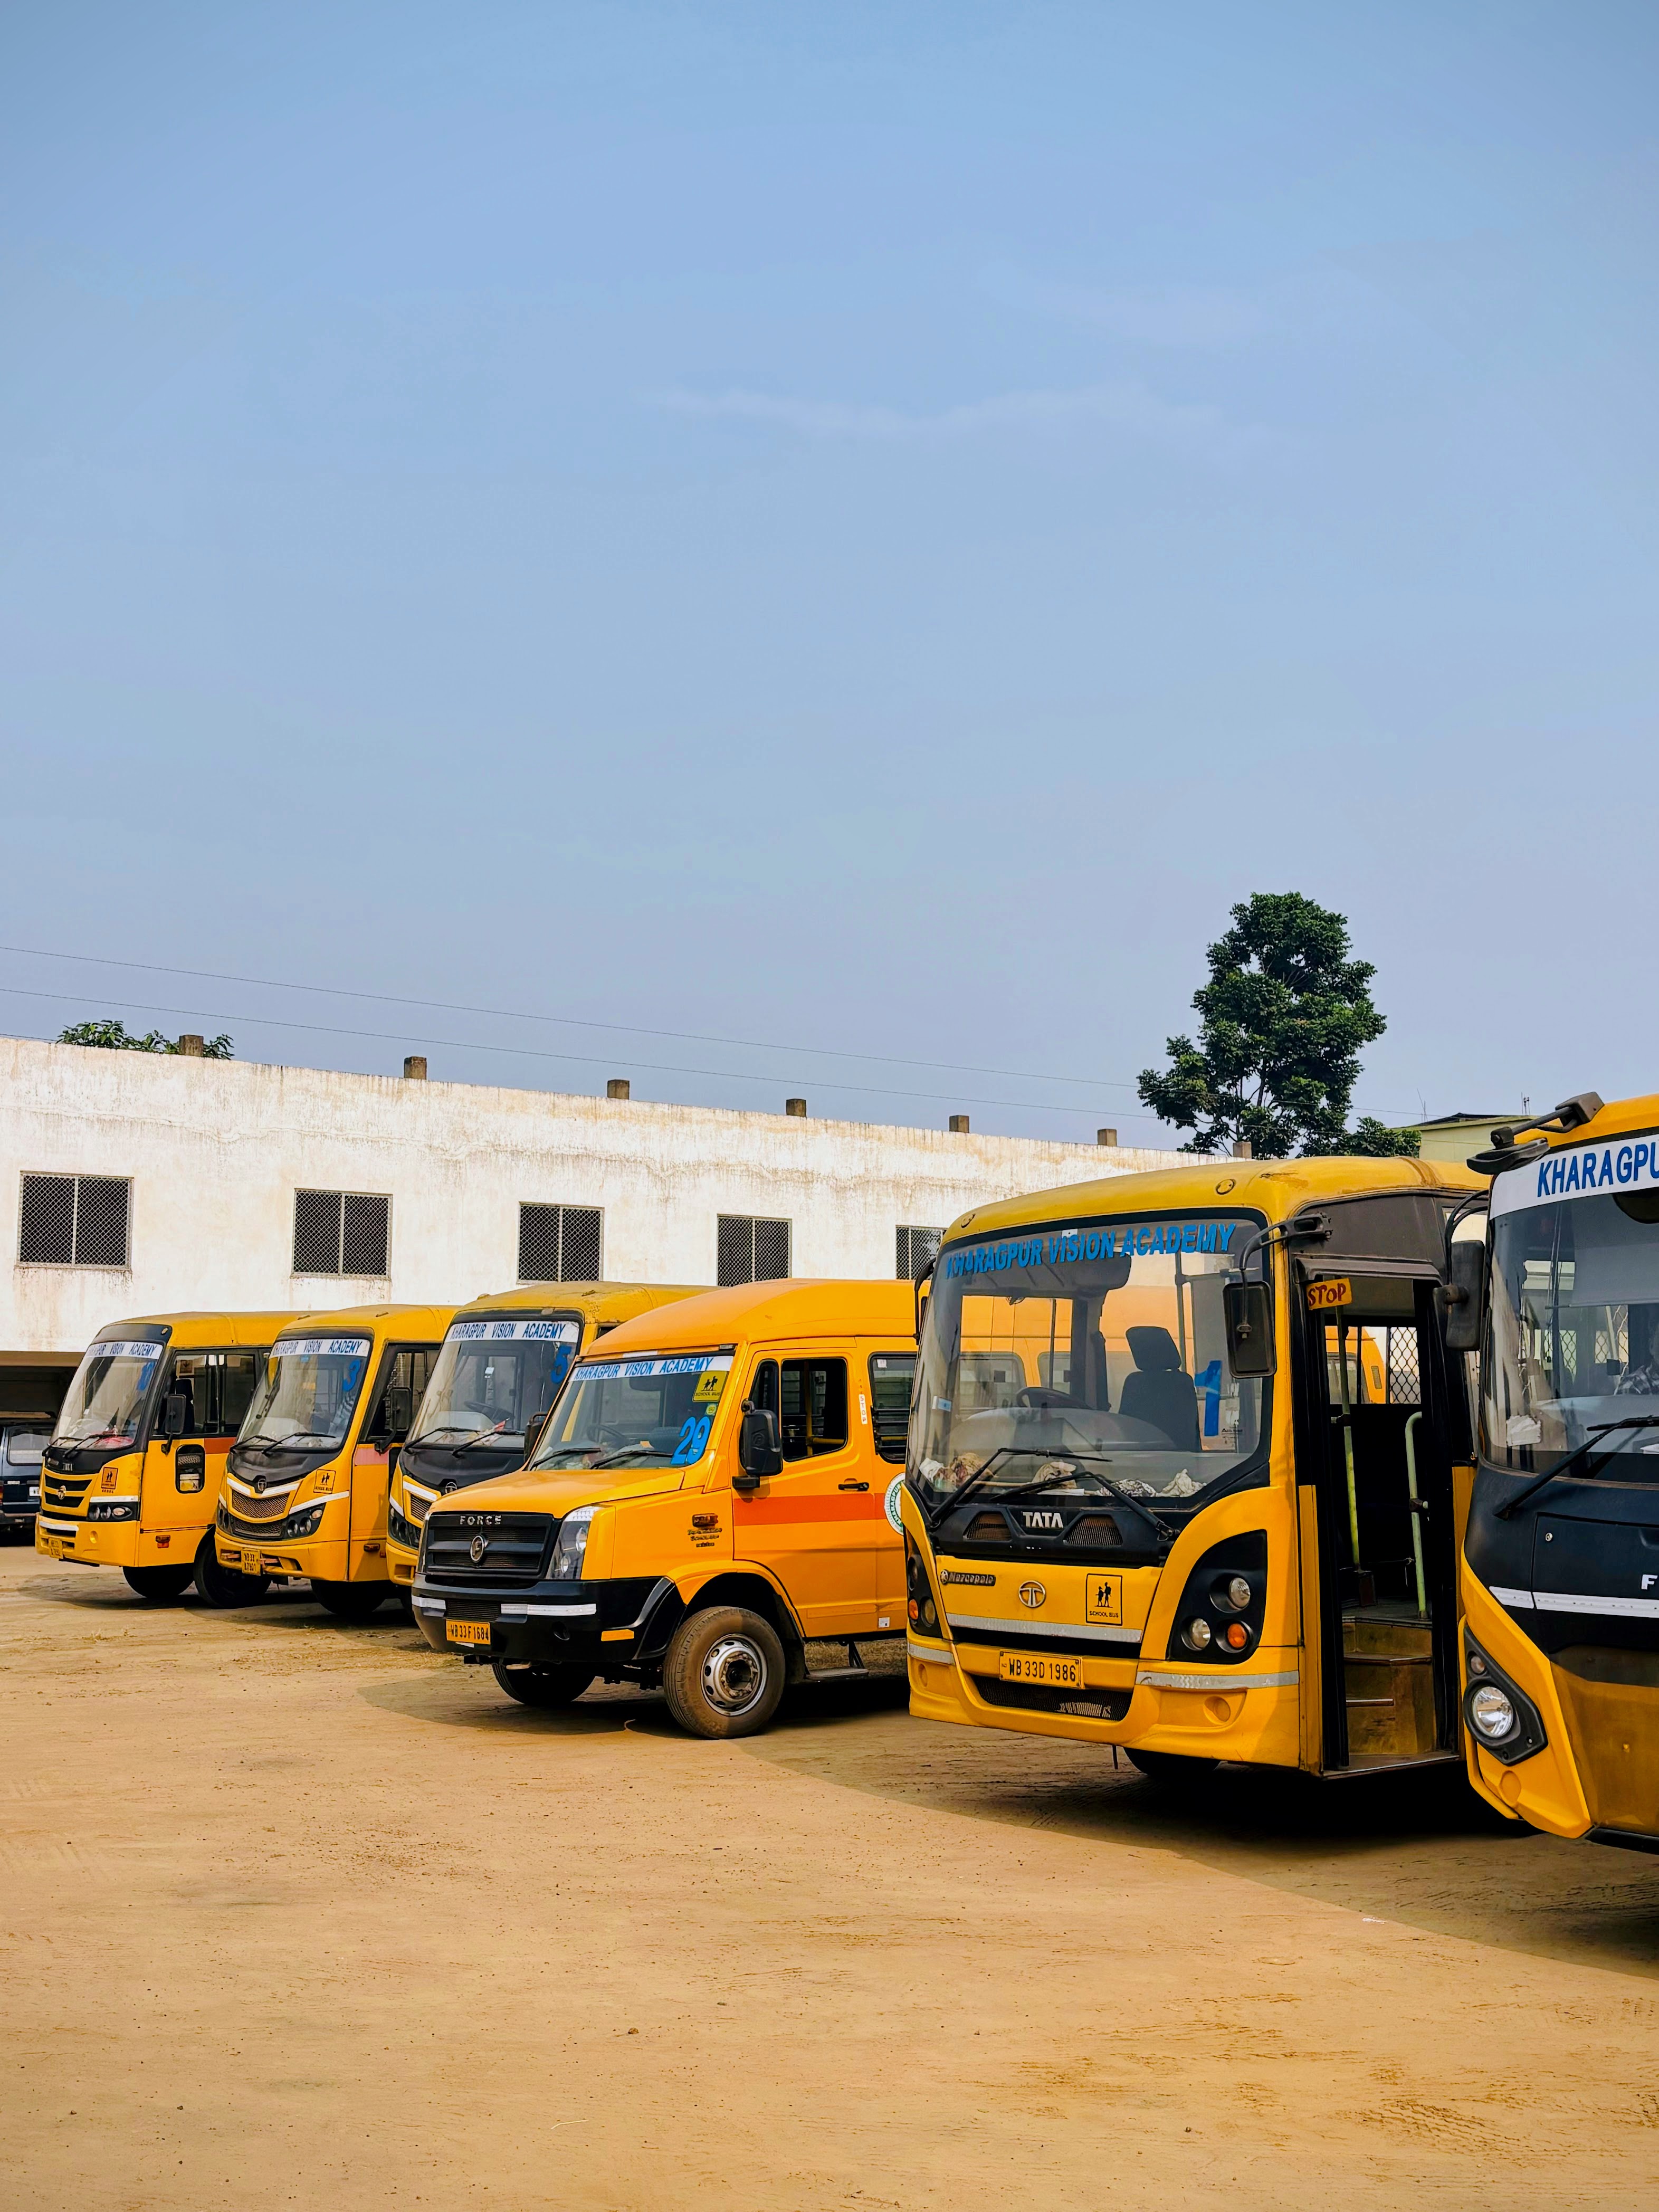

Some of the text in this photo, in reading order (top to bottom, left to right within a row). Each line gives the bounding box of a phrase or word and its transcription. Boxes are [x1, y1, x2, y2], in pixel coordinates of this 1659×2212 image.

[946, 1223, 1236, 1279] KHARAGPUR VISION ACADEMY
[1308, 1283, 1346, 1306] STOP
[450, 1323, 566, 1339] KHARAGPUR VISION ACADEMY
[129, 1343, 157, 1356] ACADEMY
[303, 1340, 323, 1353] VISION
[328, 1340, 363, 1353] ACADEMY
[342, 1359, 361, 1391] 3
[550, 1346, 571, 1384] 5
[574, 1357, 714, 1380] KHARAGPUR VISION ACADEMY
[671, 1416, 711, 1465] 29
[460, 1515, 501, 1525] FORCE
[1023, 1511, 1064, 1528] TATA
[1009, 1658, 1022, 1676] WB
[1049, 1663, 1076, 1682] 1986
